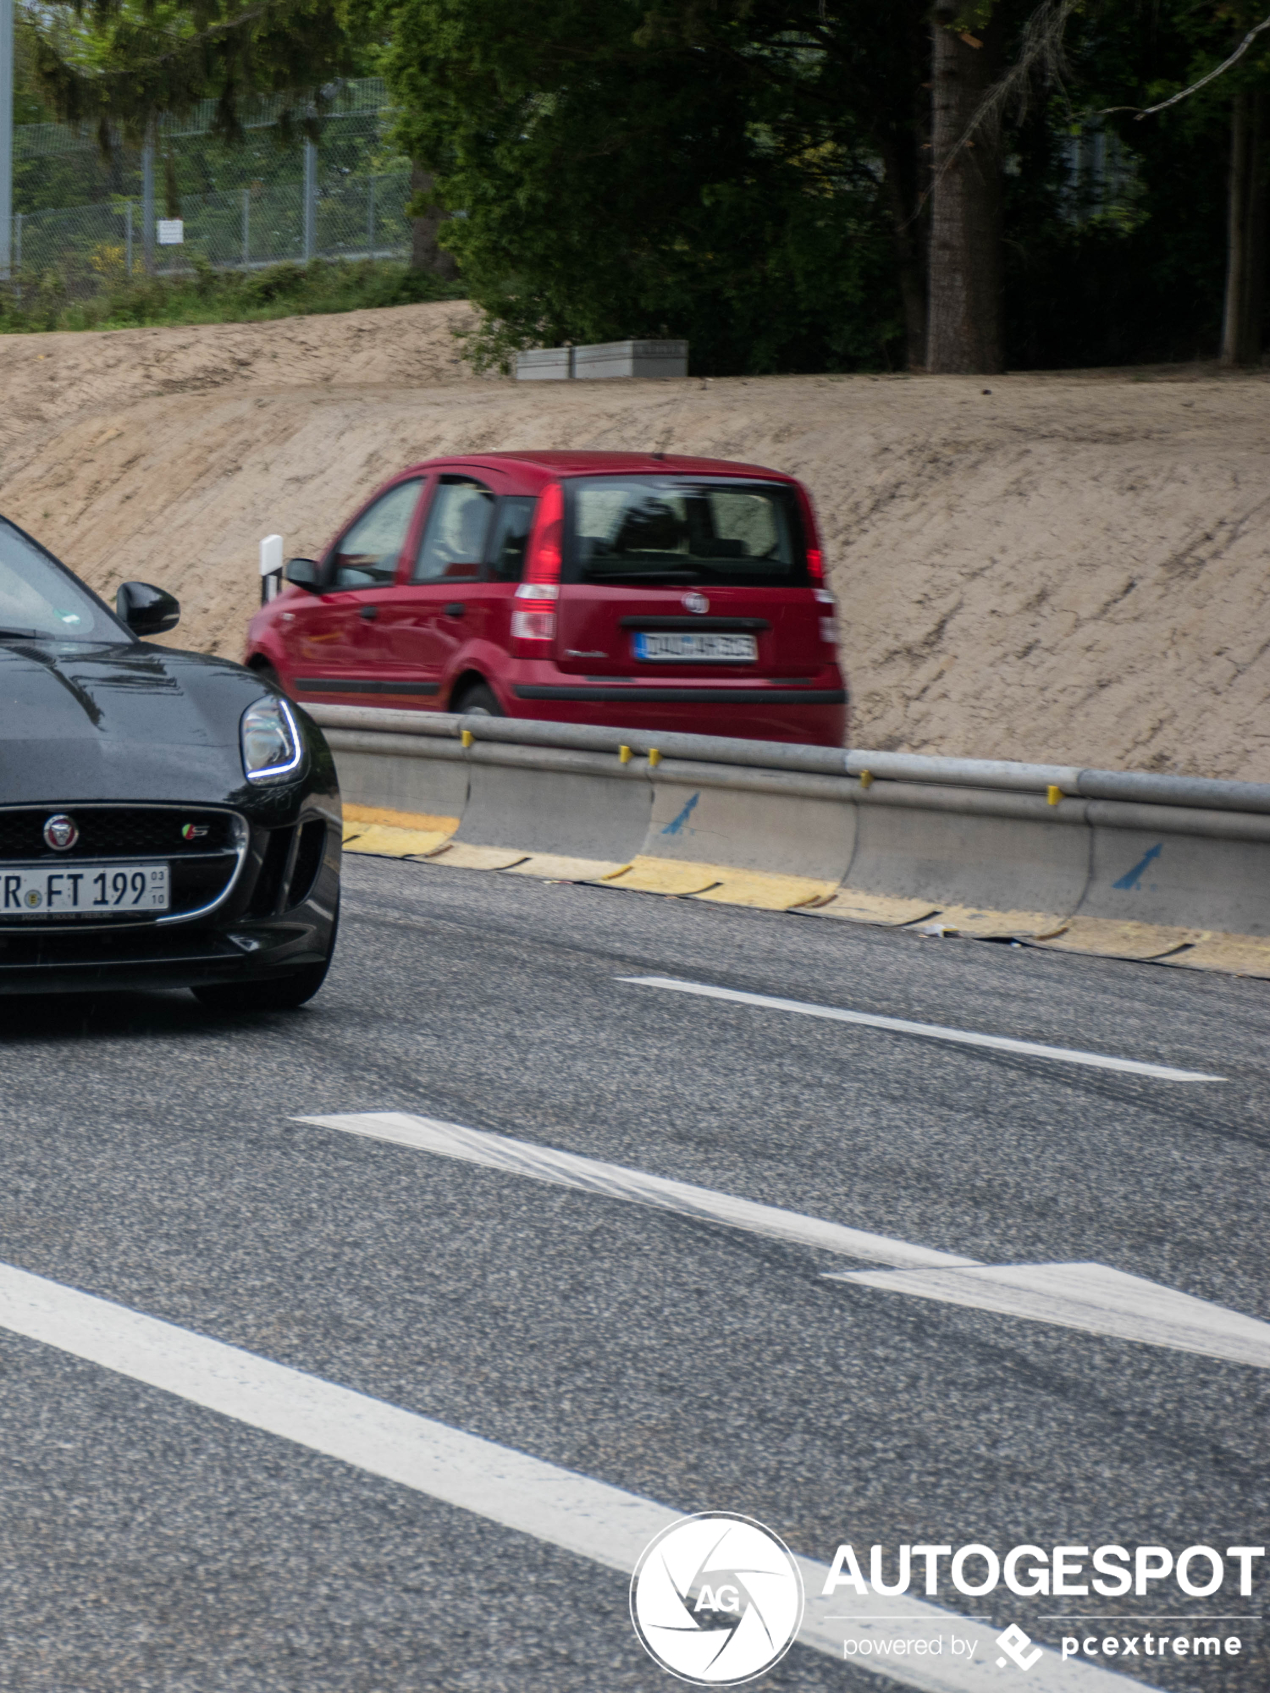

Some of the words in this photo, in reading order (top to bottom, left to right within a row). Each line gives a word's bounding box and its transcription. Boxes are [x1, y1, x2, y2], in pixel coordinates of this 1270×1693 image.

[151, 871, 165, 881] 03
[47, 874, 84, 907] FT
[93, 872, 146, 905] 199
[151, 894, 165, 904] 10
